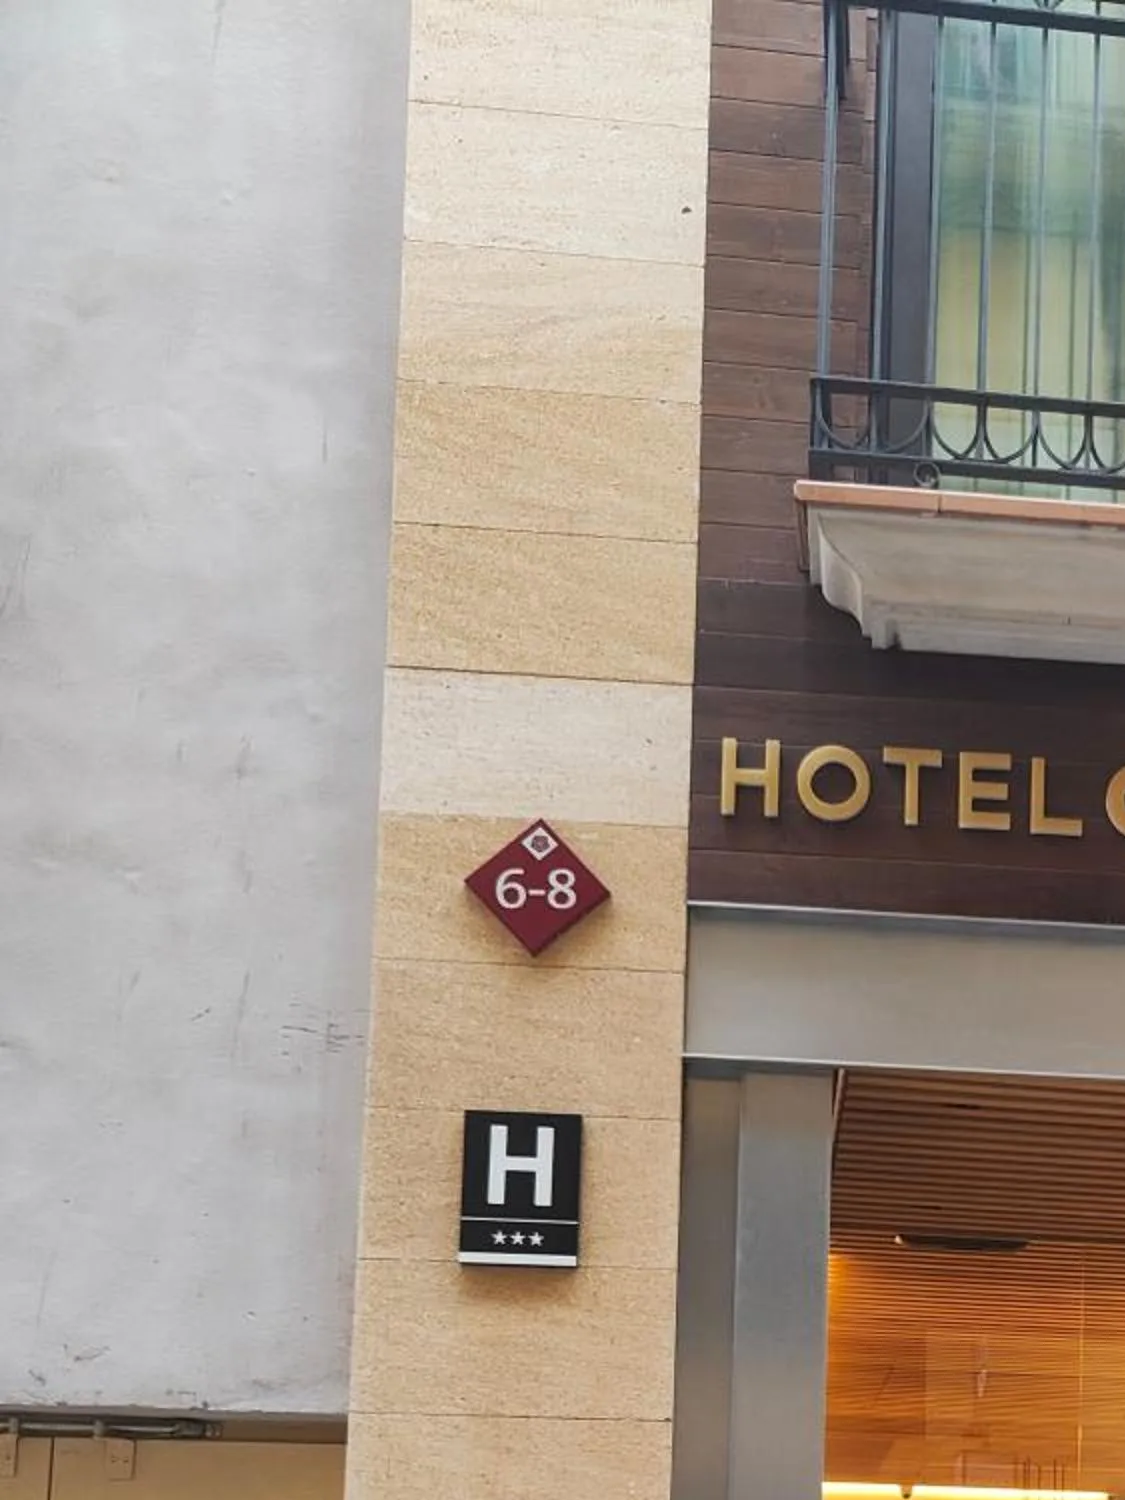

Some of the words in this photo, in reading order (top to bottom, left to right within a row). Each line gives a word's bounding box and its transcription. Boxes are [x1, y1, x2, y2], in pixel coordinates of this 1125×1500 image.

[721, 737, 1083, 837] HOTEL
[495, 867, 577, 909] 6-8
[487, 1125, 554, 1206] H
